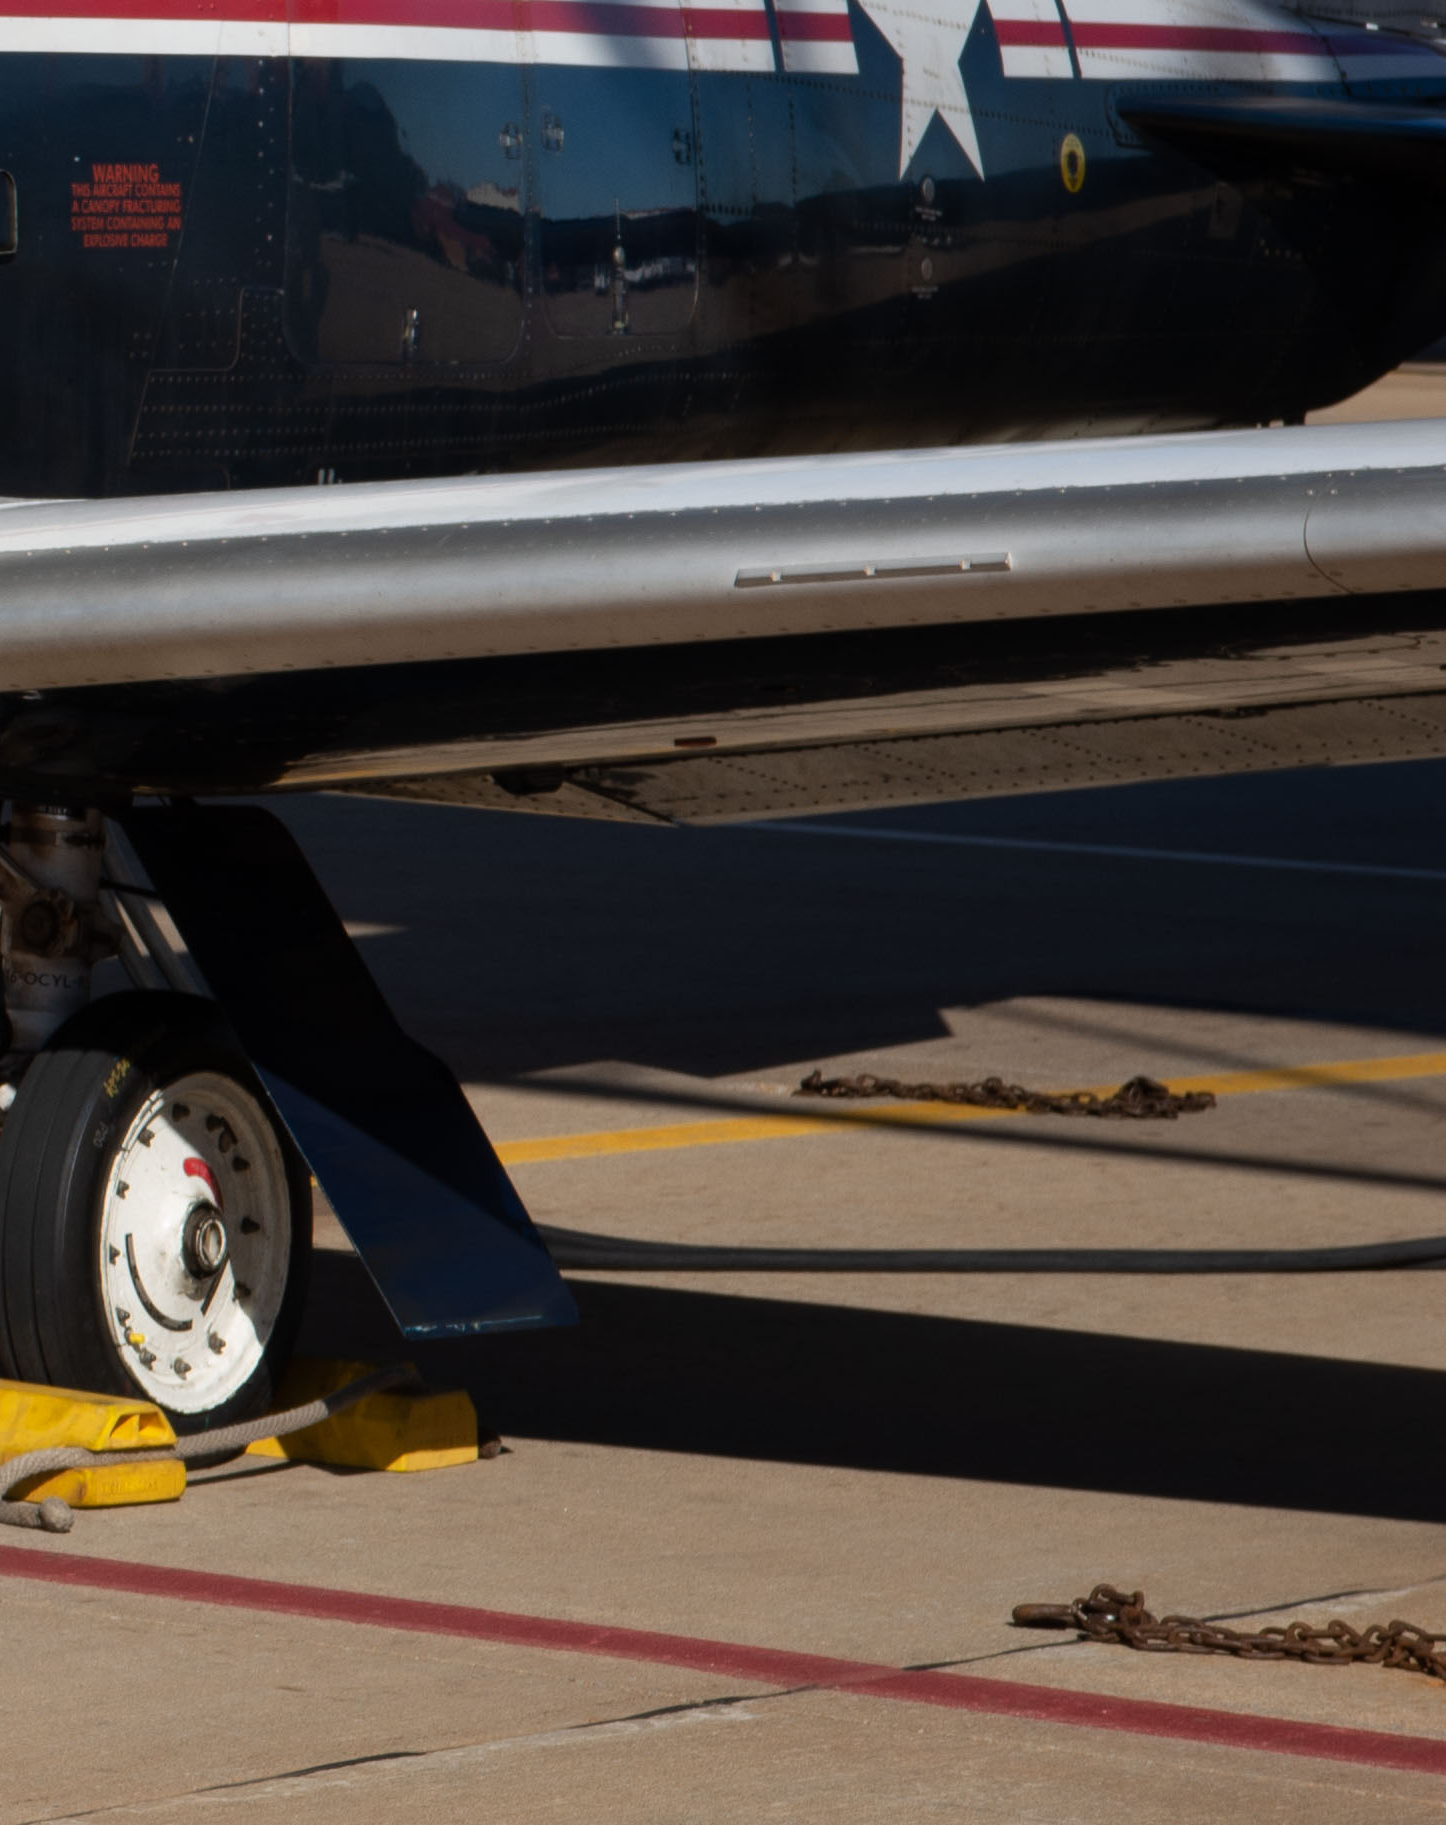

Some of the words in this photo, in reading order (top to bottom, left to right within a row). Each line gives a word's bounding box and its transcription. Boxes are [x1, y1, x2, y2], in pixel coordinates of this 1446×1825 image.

[91, 163, 160, 183] WARNING
[70, 182, 91, 197] THIS
[92, 182, 133, 197] AIRCRAFT
[134, 182, 182, 197] CONTAINS
[70, 199, 80, 214] A
[81, 199, 120, 214] CANOPY
[70, 216, 105, 231] SYSTEM
[166, 216, 182, 231] AN
